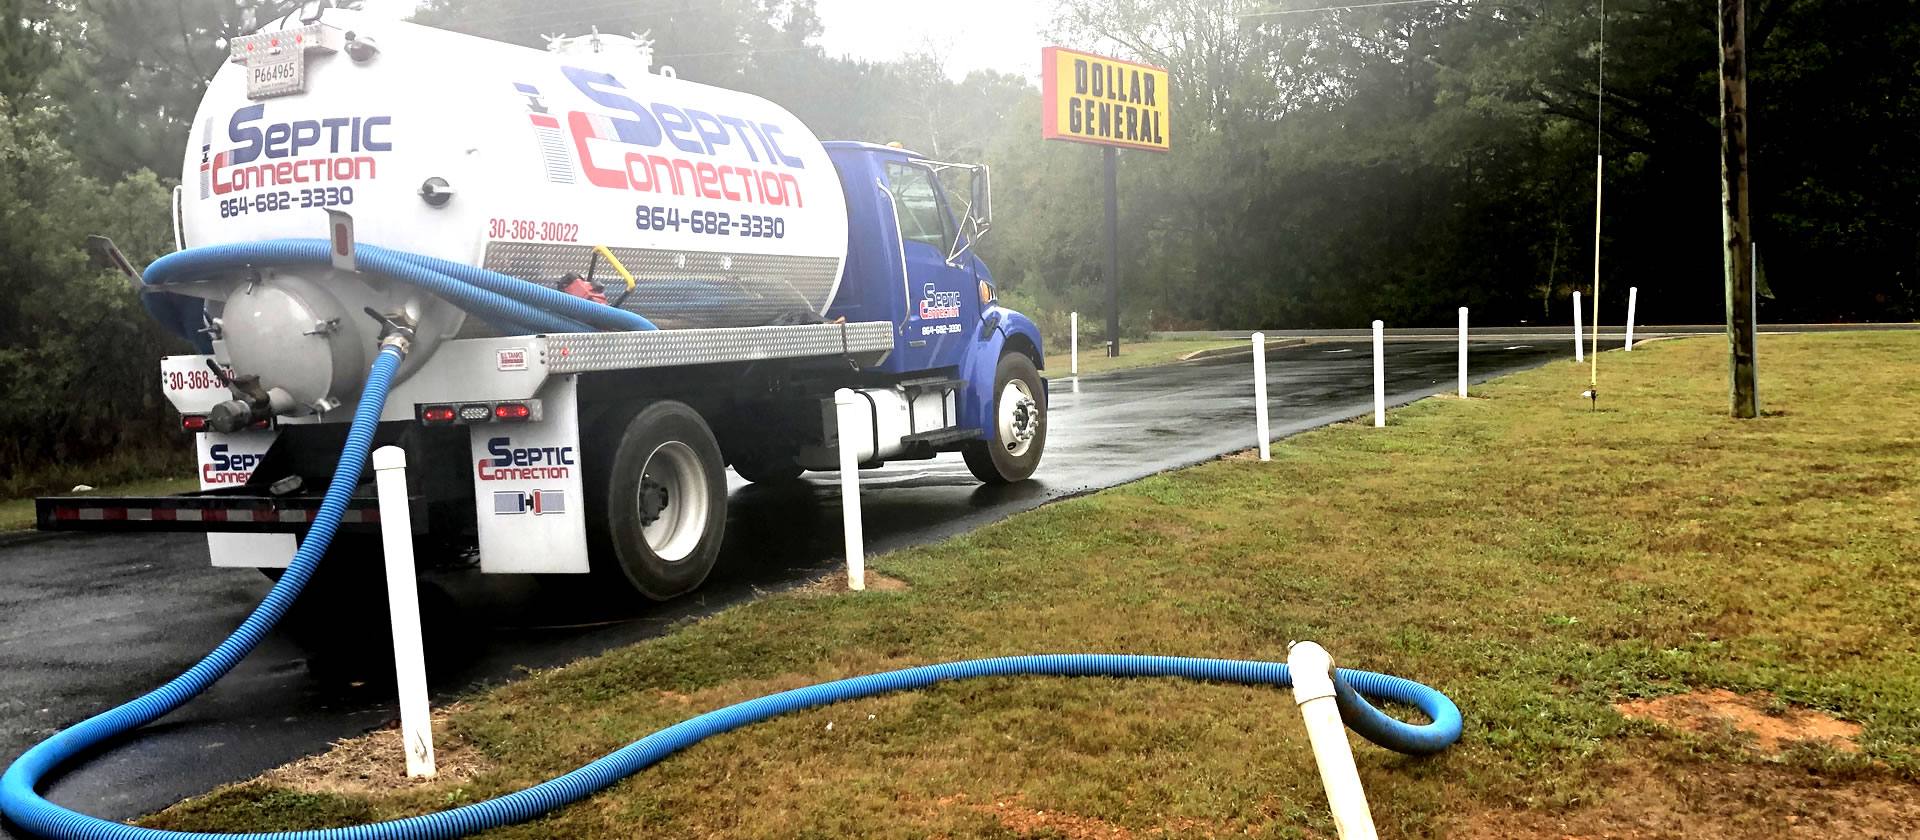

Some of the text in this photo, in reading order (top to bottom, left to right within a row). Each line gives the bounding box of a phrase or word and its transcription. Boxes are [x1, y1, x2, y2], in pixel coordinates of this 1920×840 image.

[255, 63, 294, 83] P664965
[1075, 59, 1155, 106] DOLLAR
[1069, 97, 1162, 144] GENERAL
[220, 186, 353, 218] 864-682-3330
[489, 219, 578, 242] 30-368-30022
[636, 205, 784, 239] 864-682-3330
